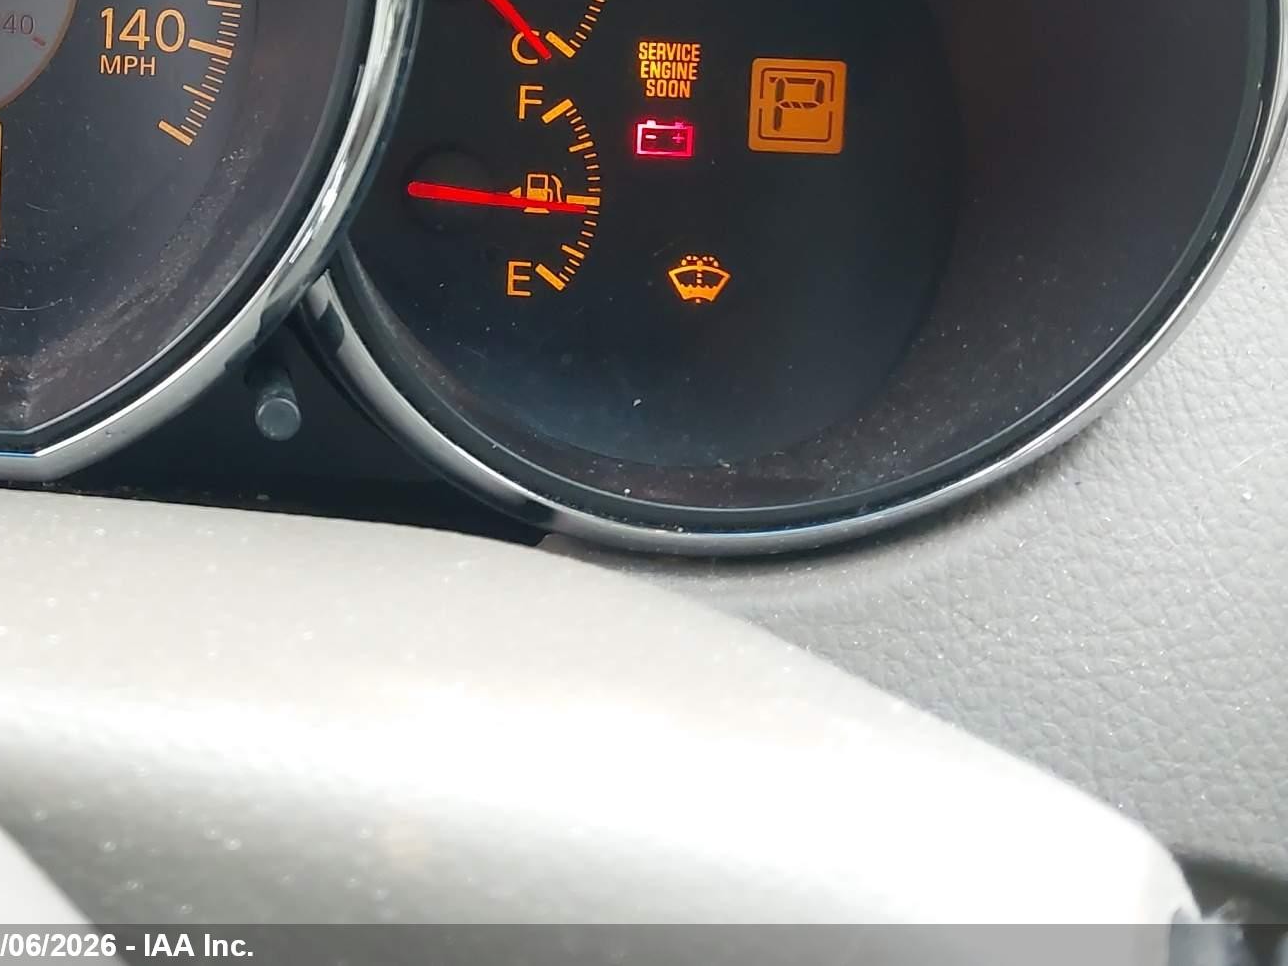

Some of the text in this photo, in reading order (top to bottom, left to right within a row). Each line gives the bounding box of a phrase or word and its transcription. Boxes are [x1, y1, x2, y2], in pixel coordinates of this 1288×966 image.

[101, 8, 186, 52] 140
[511, 30, 540, 65] C
[100, 55, 156, 76] MPH
[638, 41, 701, 62] SERVICE
[640, 60, 698, 80] ENGINE
[518, 84, 543, 119] F
[646, 79, 691, 98] SOON
[769, 77, 825, 132] P
[507, 260, 532, 296] E
